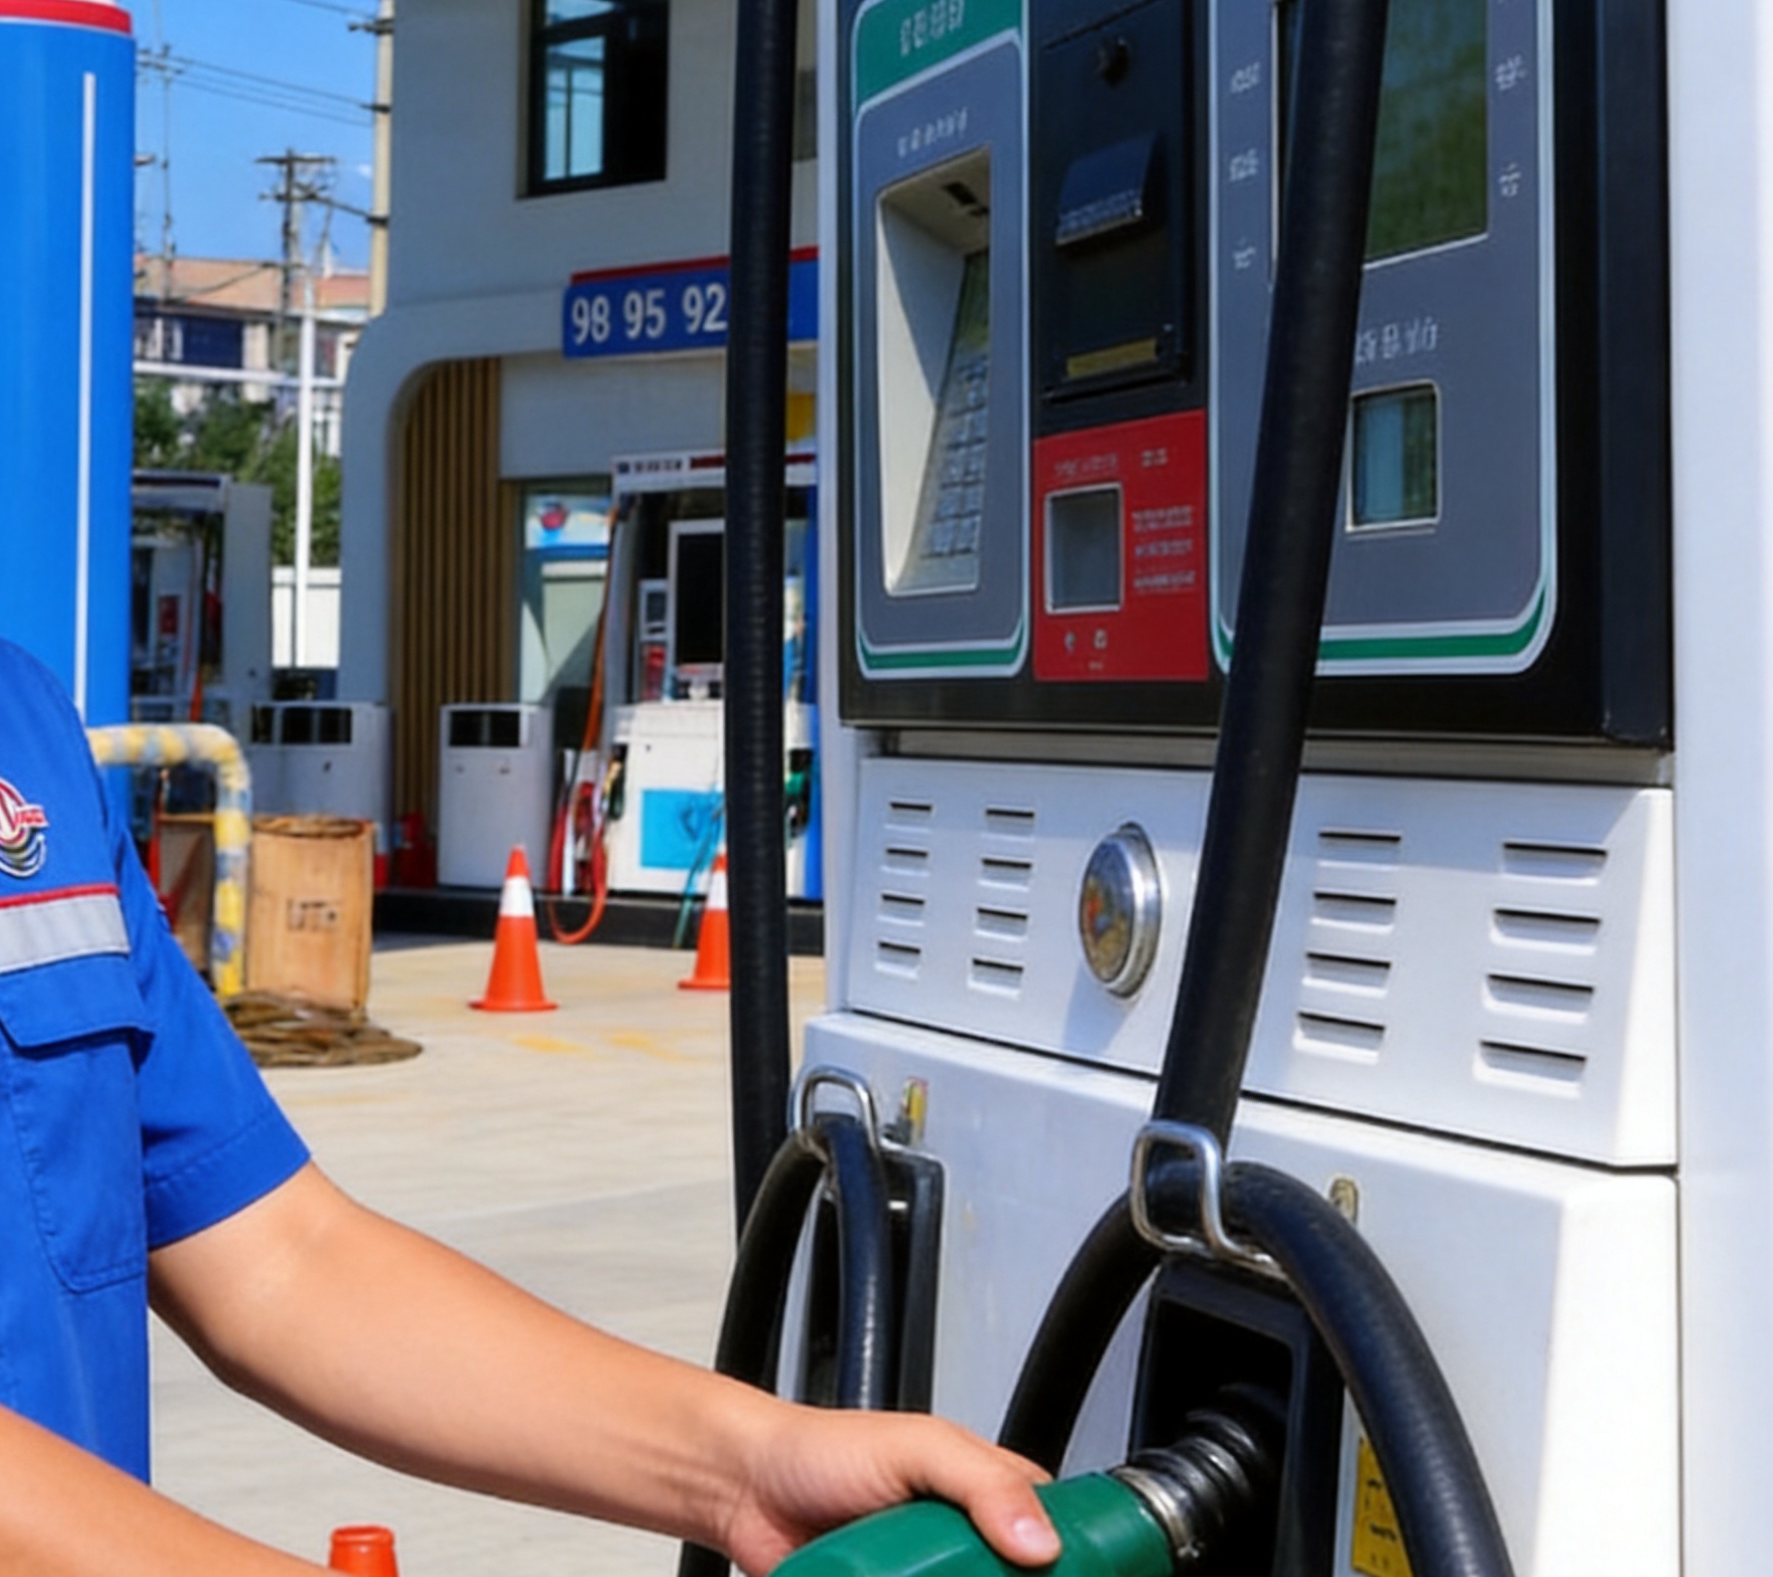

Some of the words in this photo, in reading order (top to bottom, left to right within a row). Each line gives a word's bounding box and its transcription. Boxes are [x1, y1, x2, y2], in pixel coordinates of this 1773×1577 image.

[571, 295, 611, 346] 98
[623, 288, 667, 340] 95
[682, 282, 729, 335] 92
